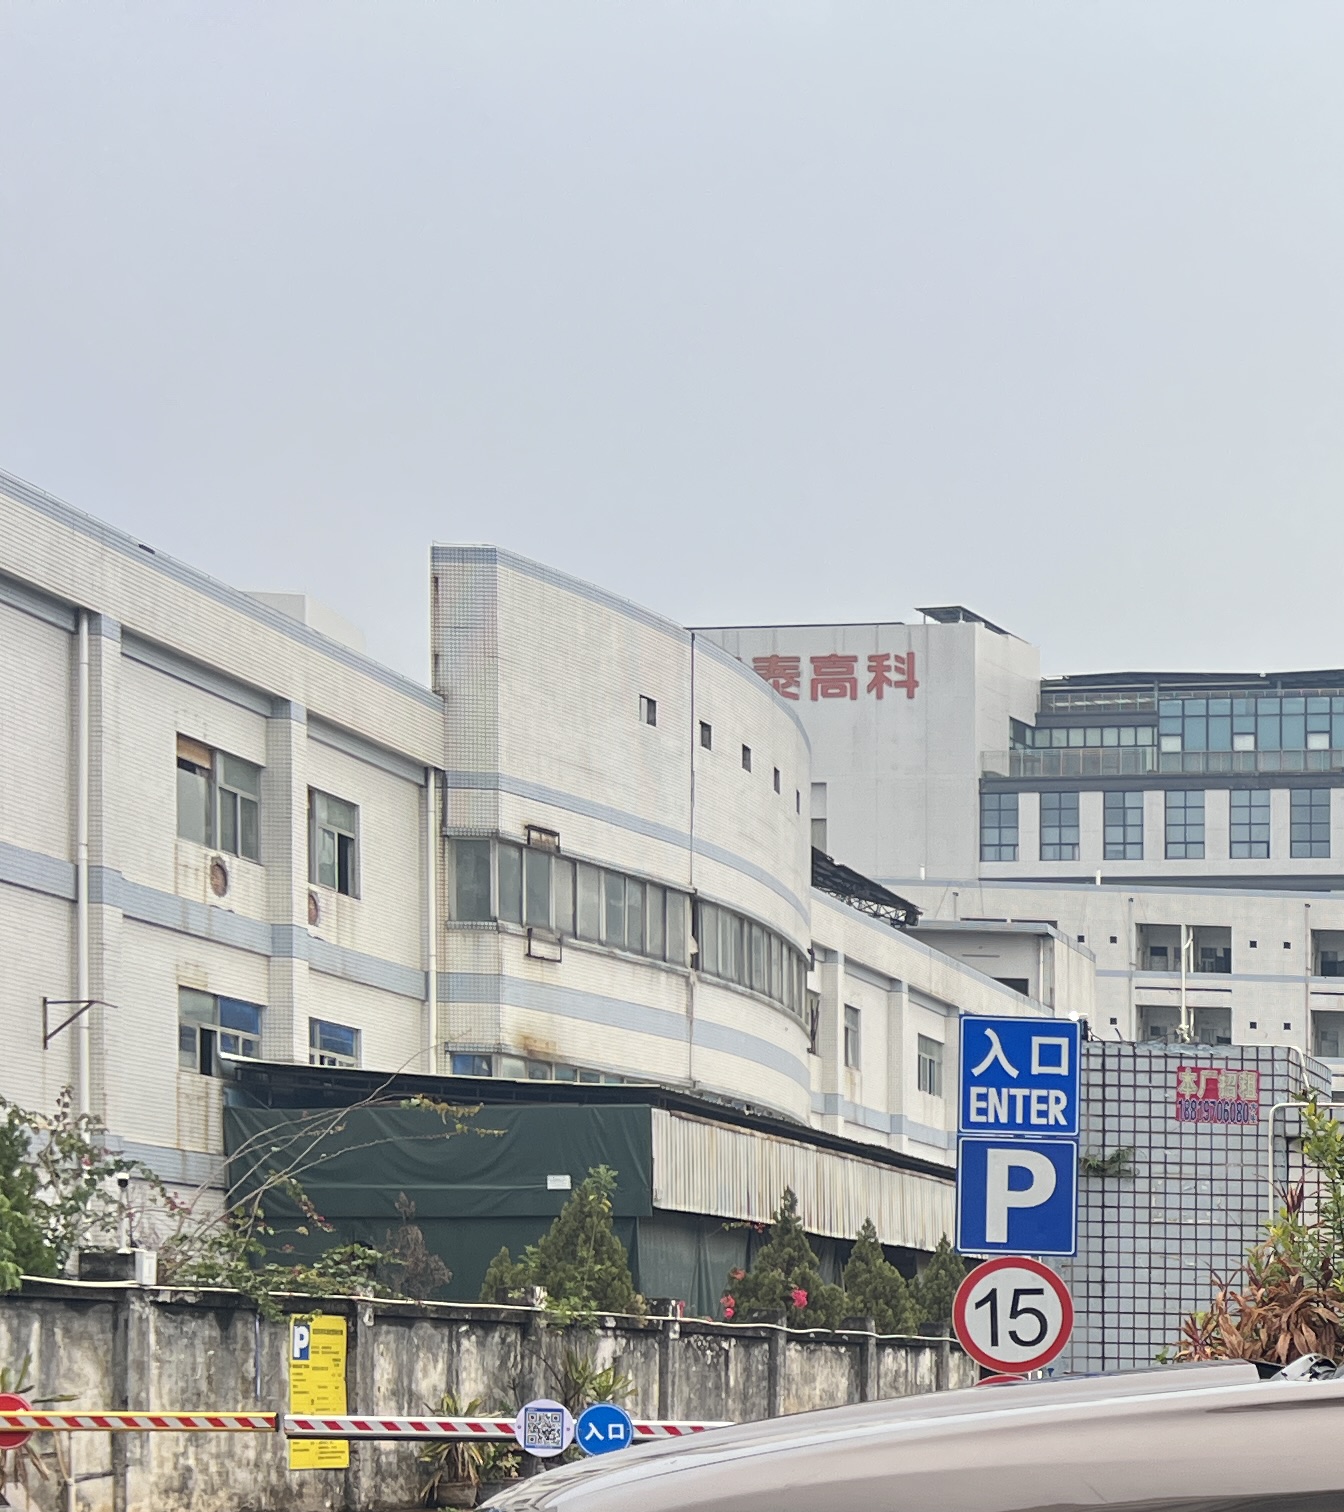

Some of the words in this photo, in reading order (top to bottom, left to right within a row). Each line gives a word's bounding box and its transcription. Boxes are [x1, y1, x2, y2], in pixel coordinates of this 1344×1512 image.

[970, 1027, 1070, 1079] 入口
[1178, 1067, 1258, 1100] 本厂招租
[969, 1086, 1068, 1126] ENTER
[985, 1148, 1057, 1243] P
[974, 1287, 1049, 1347] 15
[293, 1325, 309, 1358] P
[584, 1422, 625, 1440] 入口
